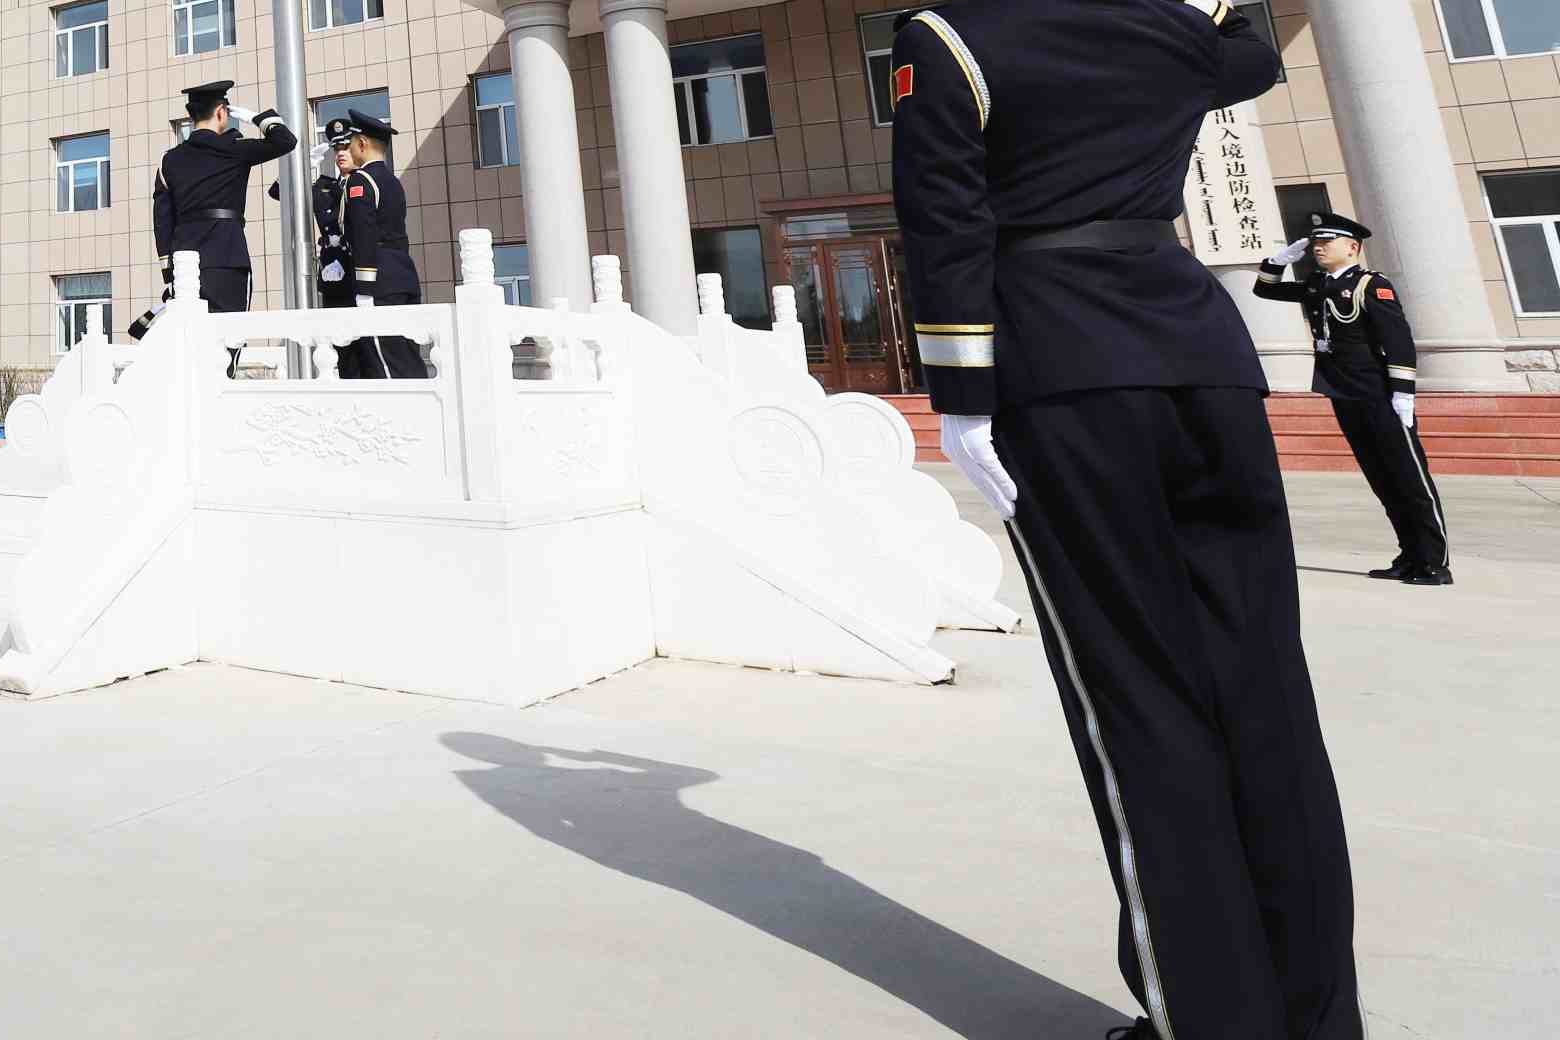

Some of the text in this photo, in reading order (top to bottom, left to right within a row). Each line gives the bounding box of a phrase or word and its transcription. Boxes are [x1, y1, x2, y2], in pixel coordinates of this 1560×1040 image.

[1214, 108, 1263, 250] 出入境边防检查站
